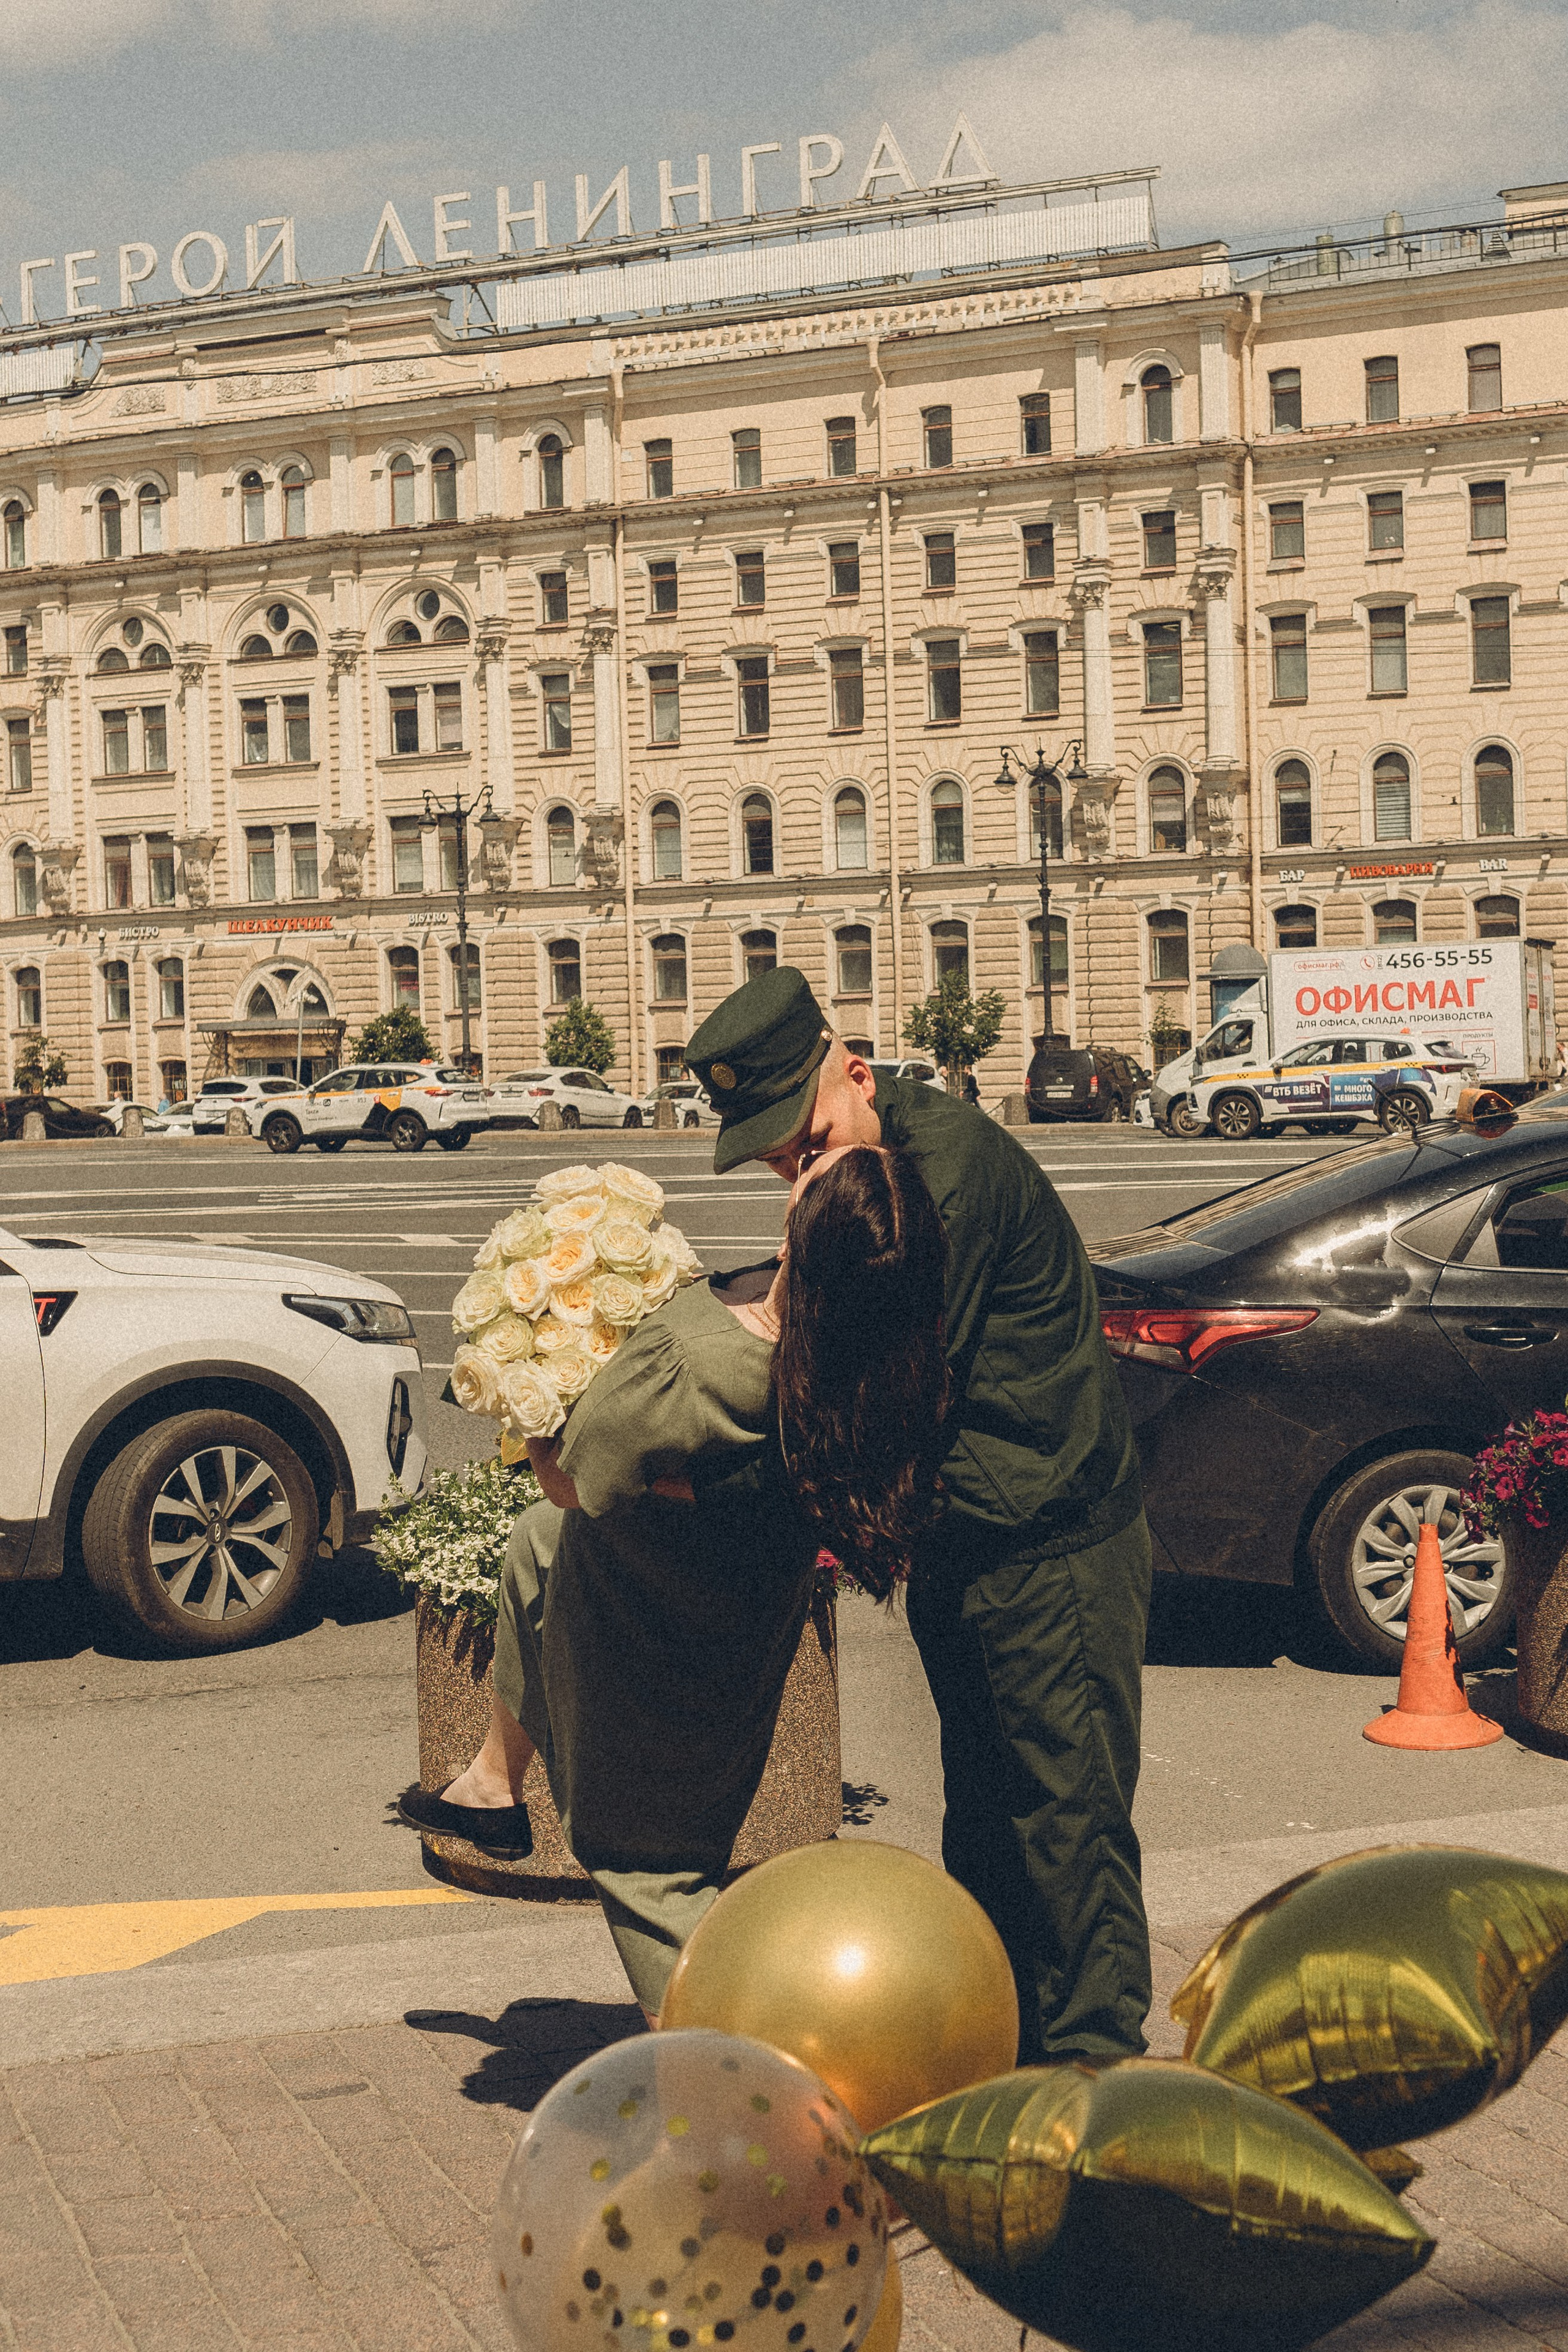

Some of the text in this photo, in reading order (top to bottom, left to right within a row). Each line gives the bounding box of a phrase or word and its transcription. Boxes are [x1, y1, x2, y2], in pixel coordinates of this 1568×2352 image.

[20, 111, 998, 325] ГЕРОЙ ЛЕНИНГРАД
[1349, 862, 1433, 878] ПИВОВАРНЯ
[1479, 858, 1508, 871] BAR
[1279, 869, 1305, 881] БАР
[227, 916, 333, 933] ЩЕЛКУНЧИК
[408, 911, 448, 924] BISTRO
[118, 926, 159, 938] БИСТРО
[1298, 962, 1340, 970] офисмаг.рф
[1385, 948, 1493, 969] 456-55-55
[1295, 978, 1486, 1016] ОФИСМАГ
[1296, 1011, 1493, 1029] ДЛЯ ОФИСА, СКЛАДА, ПРОИЗВОДСТВА
[1273, 1082, 1322, 1098] ВТБ ВЕЗЁТ
[1344, 1084, 1373, 1093] МНОГО
[1335, 1093, 1373, 1102] КЕШБЭКА
[34, 1298, 57, 1324] T
